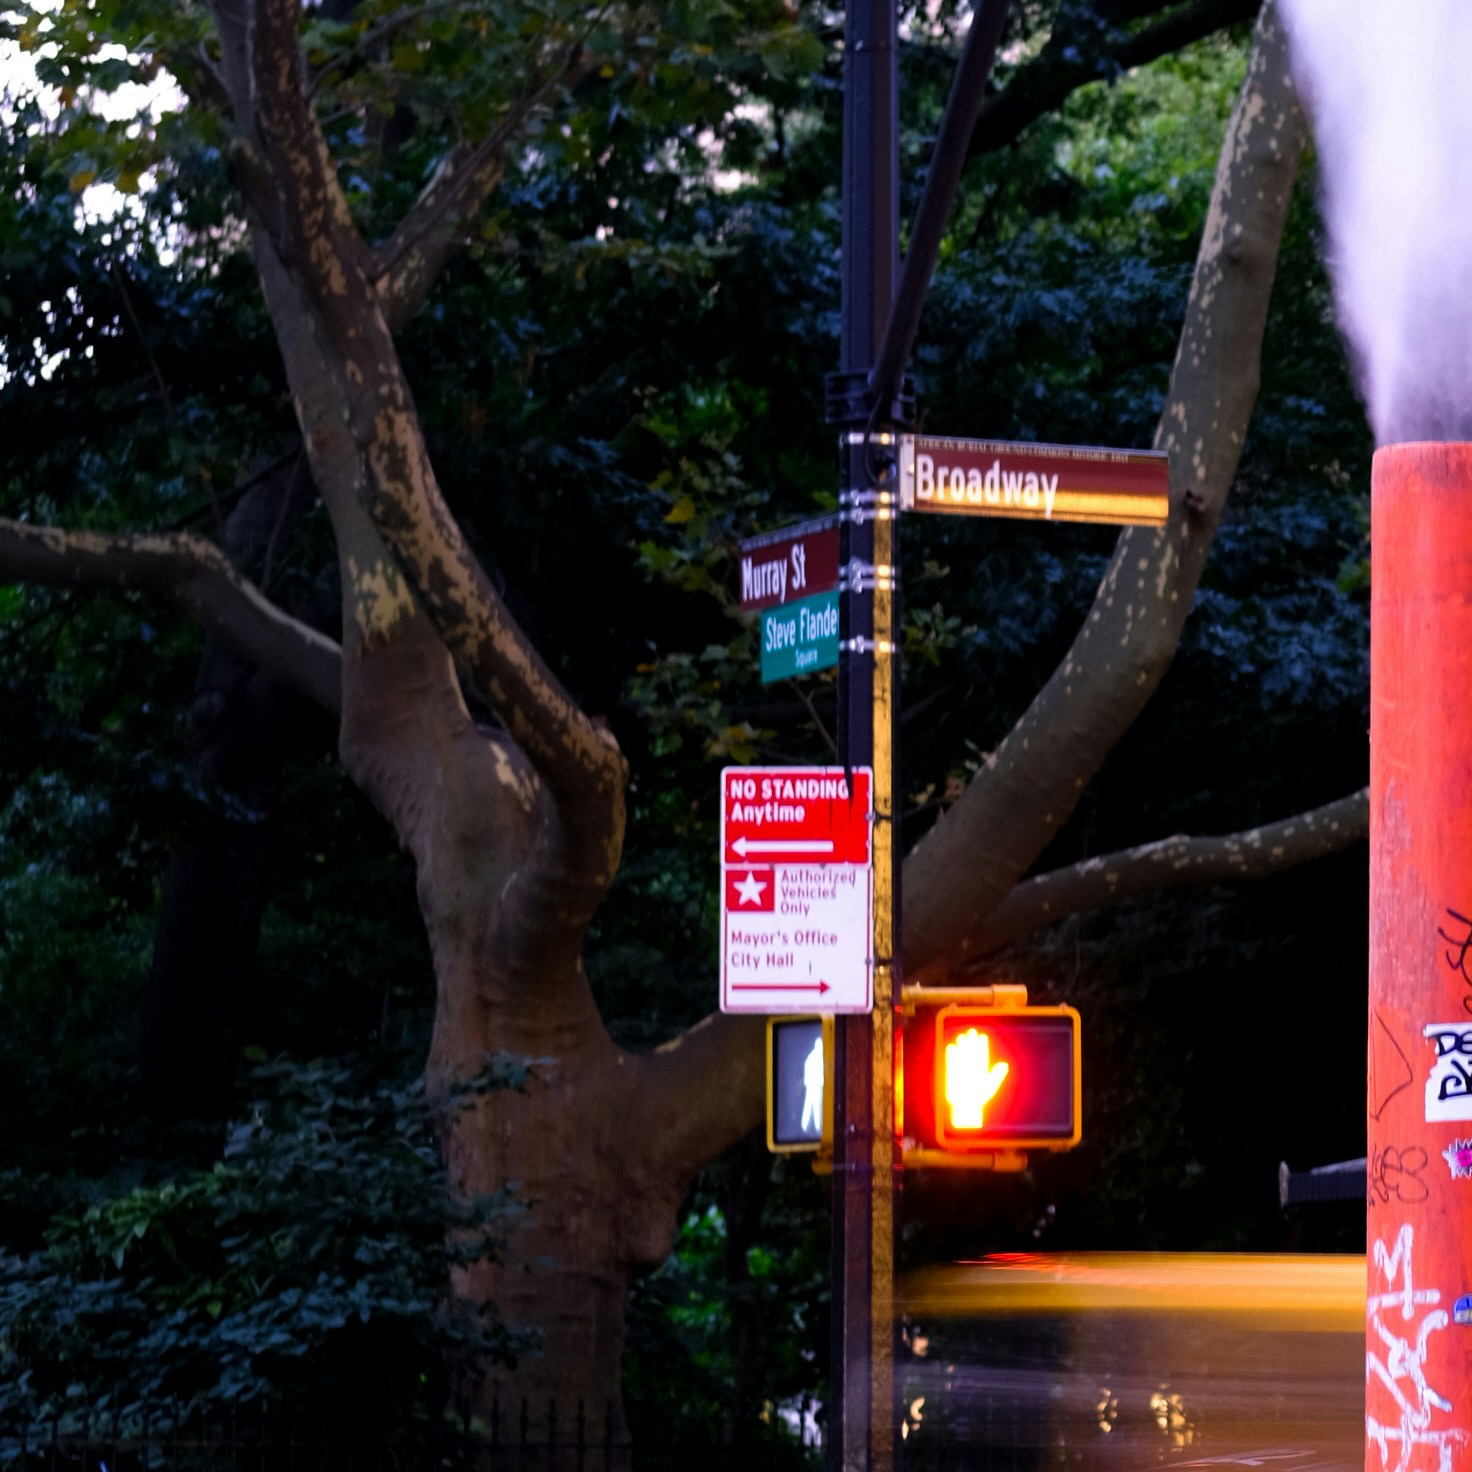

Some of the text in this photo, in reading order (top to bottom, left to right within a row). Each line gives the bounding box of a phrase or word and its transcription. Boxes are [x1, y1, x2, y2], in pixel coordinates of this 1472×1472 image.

[917, 454, 1059, 519] Broadway
[741, 543, 807, 604] Murray St
[765, 602, 839, 653] Steve Flande
[731, 778, 850, 800] NO STANDING
[731, 802, 805, 826] Anytime
[781, 869, 856, 884] Authorized
[781, 885, 836, 899] Vehicles
[781, 900, 810, 916] Only
[731, 929, 838, 947] Mayor's Office
[731, 952, 794, 970] City Hall
